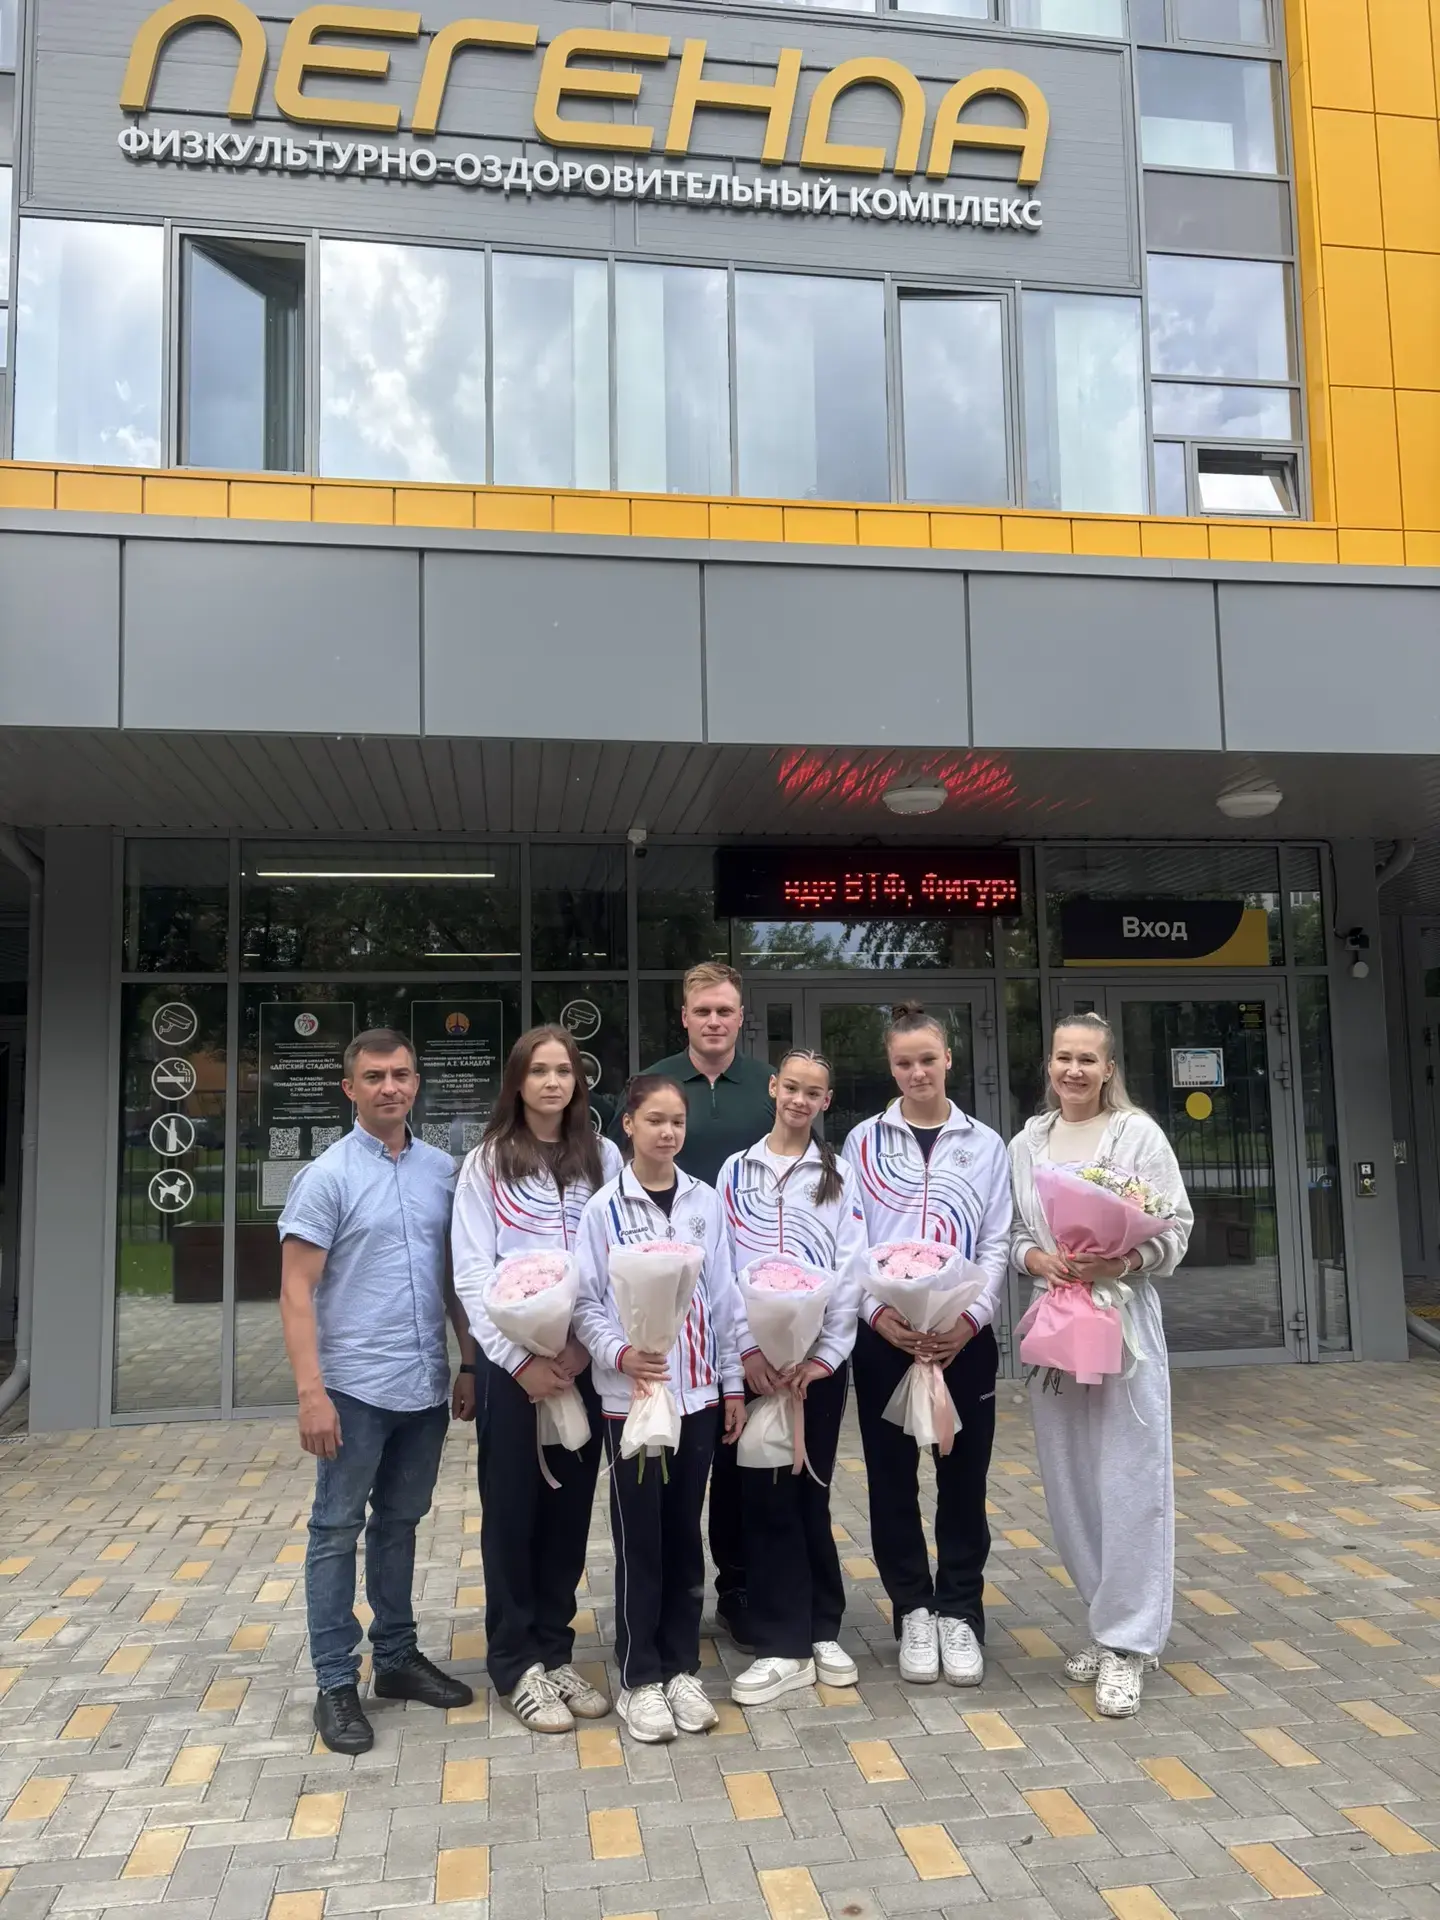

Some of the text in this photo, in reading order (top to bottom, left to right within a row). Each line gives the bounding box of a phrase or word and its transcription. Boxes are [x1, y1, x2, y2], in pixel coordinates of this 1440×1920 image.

[118, 0, 1050, 187] ЛЕГЕНДА
[117, 126, 1043, 230] ФИЗКУЛЬТУРНО-ОЗДОРОВИТЕЛЬНЫЙ КОМПЛЕКС
[1122, 916, 1188, 941] Вход
[270, 1062, 343, 1071] «ДЕТСКИЙ СТАДИОН»
